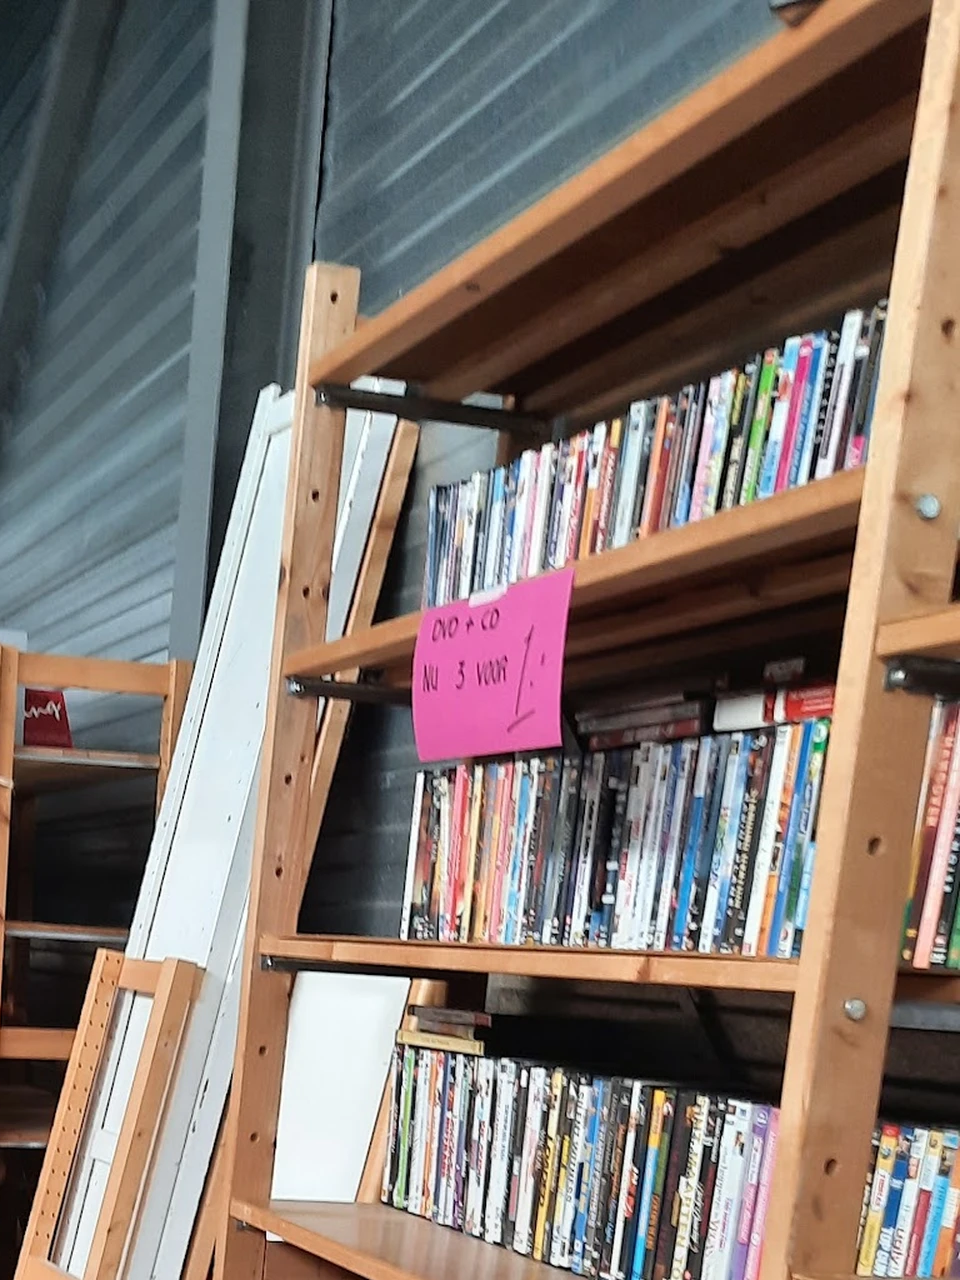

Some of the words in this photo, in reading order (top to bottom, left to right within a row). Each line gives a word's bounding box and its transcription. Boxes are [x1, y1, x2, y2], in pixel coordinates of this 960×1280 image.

[481, 608, 500, 629] CD
[422, 665, 439, 693] NU
[456, 661, 465, 690] 3
[477, 655, 509, 687] VOOR
